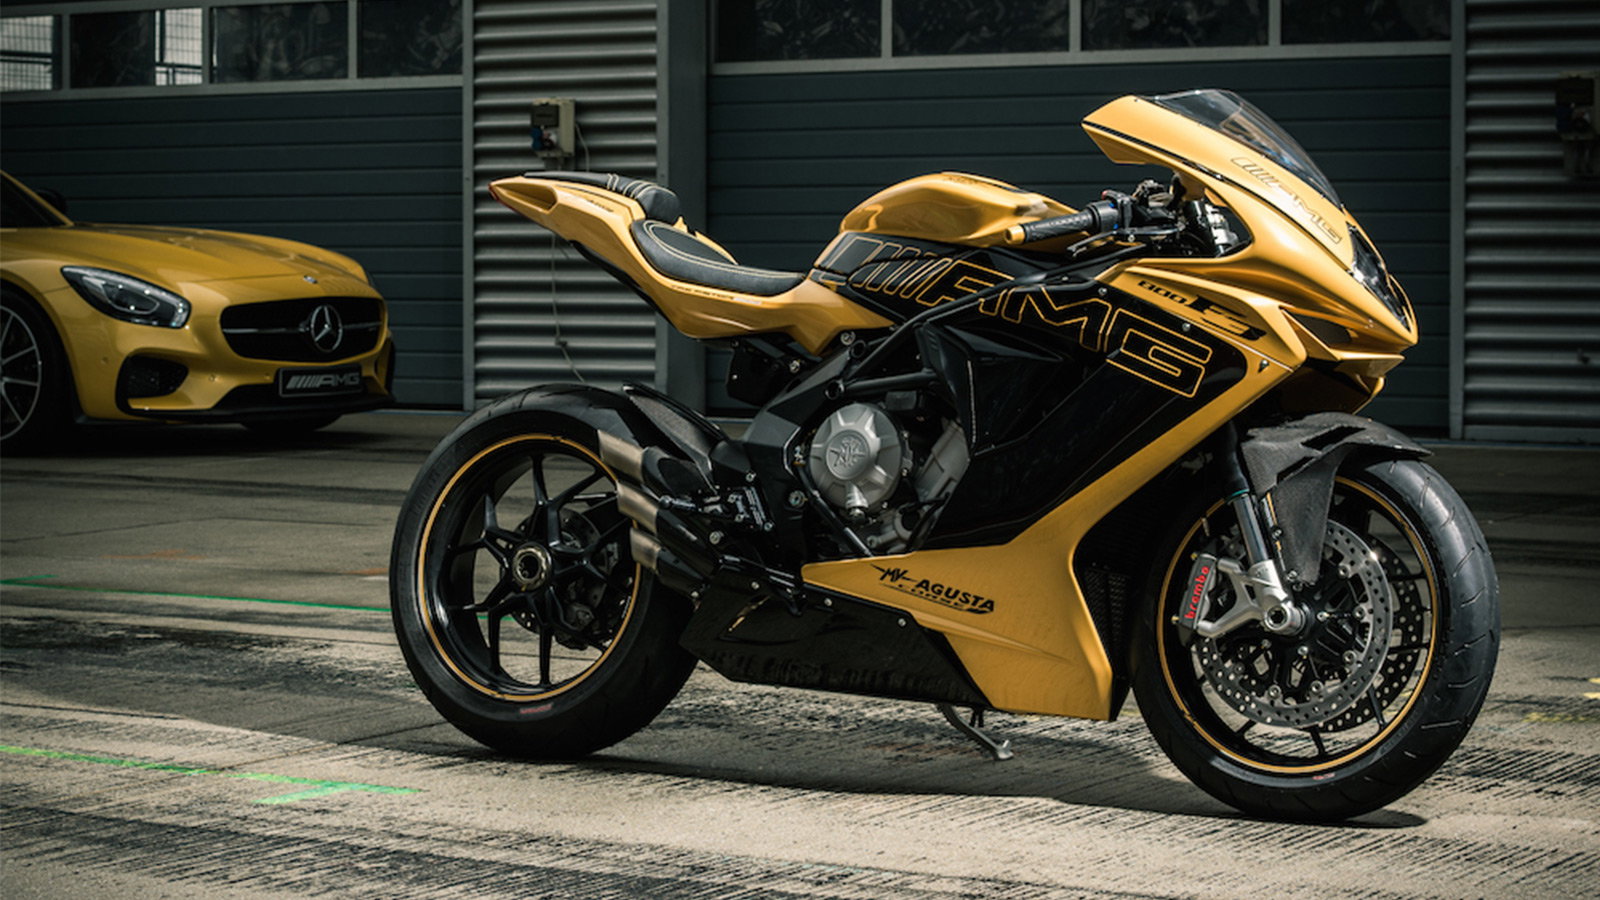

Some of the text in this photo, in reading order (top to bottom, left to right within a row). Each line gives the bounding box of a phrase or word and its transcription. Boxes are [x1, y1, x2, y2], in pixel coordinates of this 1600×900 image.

[1138, 280, 1188, 304] 800
[916, 258, 1213, 398] AMG
[317, 372, 360, 387] AMG
[872, 564, 912, 582] MV
[915, 579, 995, 612] AGUSTA
[1184, 566, 1210, 619] brembo
